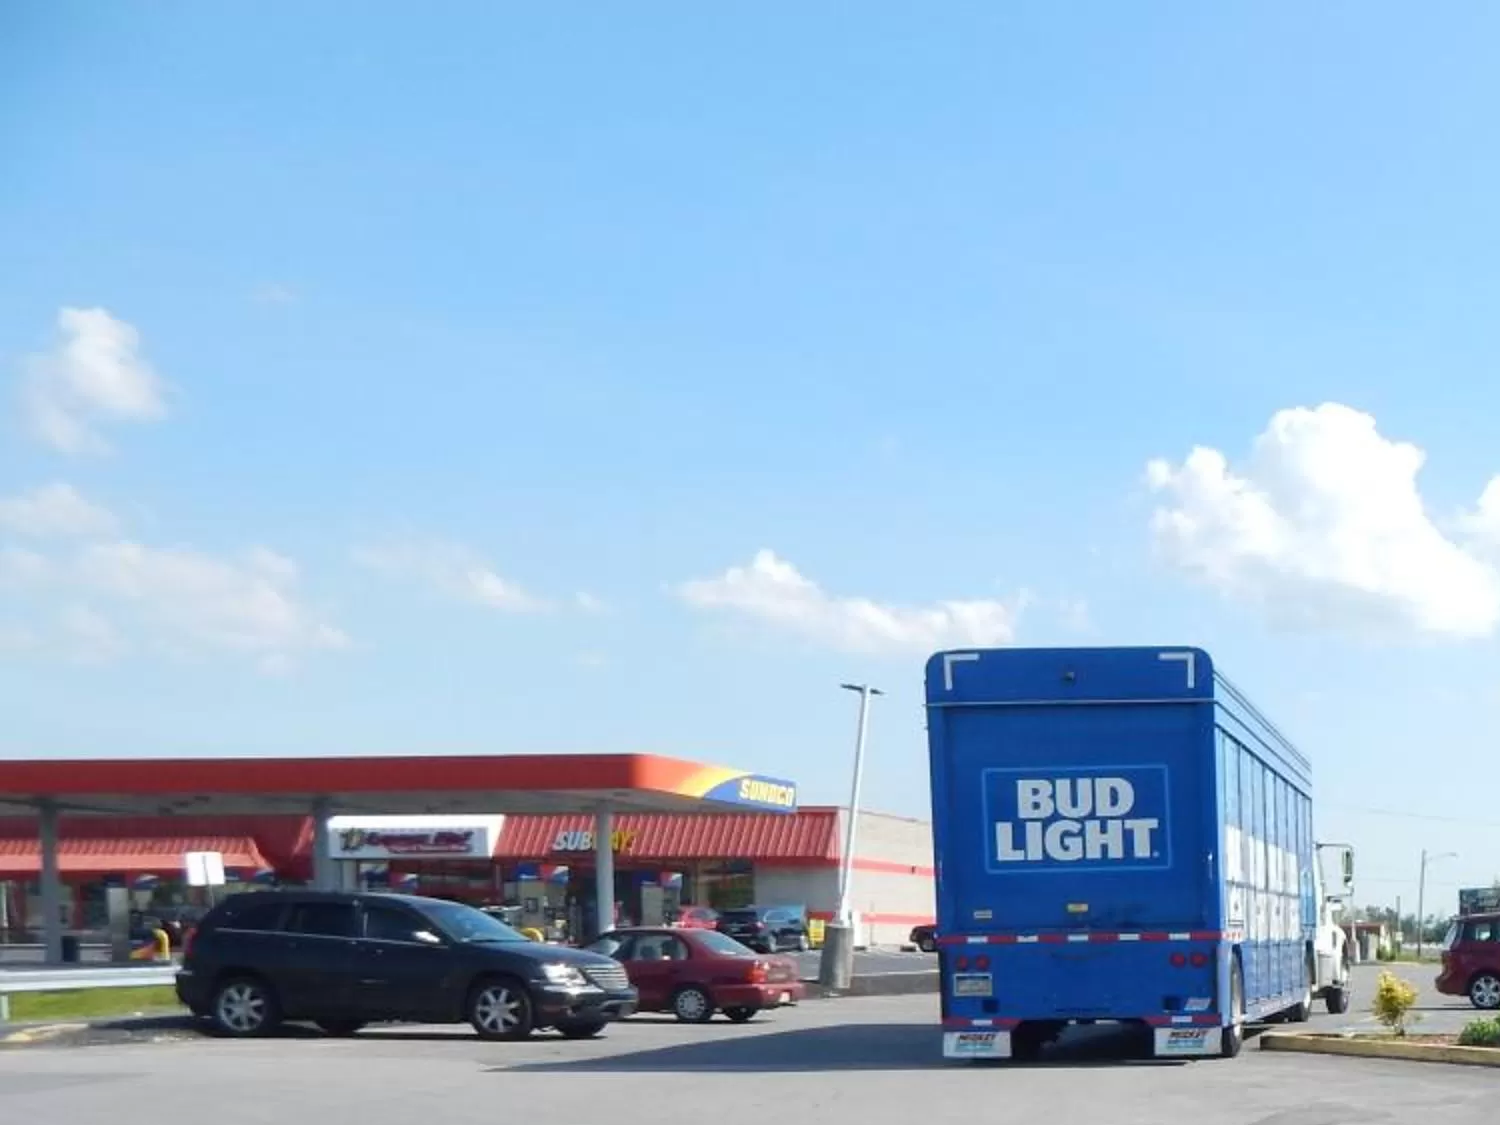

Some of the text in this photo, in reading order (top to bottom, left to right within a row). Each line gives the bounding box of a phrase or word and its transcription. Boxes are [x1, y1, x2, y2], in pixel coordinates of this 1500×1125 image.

[740, 778, 795, 807] SUNOCO
[1017, 778, 1135, 818] BUD
[996, 818, 1159, 861] LIGHT
